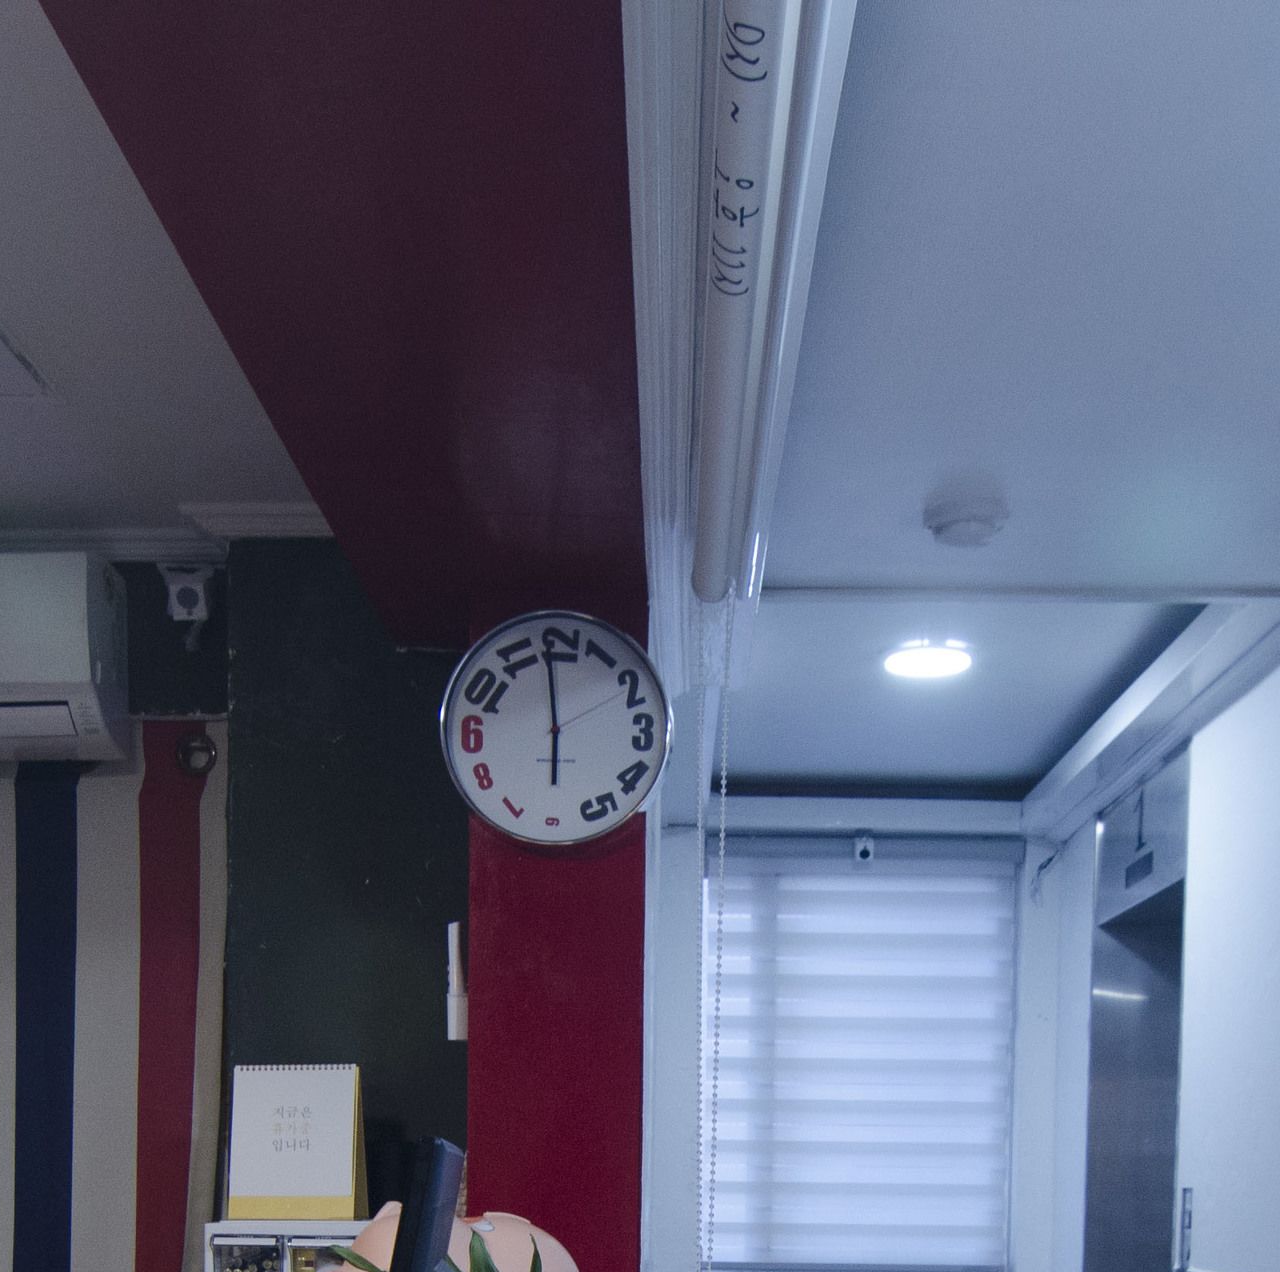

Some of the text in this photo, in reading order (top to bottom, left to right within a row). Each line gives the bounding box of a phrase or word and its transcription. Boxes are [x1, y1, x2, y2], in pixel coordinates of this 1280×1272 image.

[617, 668, 647, 710] 2
[632, 713, 654, 752] 3
[473, 762, 494, 791] 8
[616, 760, 650, 796] 4
[272, 1138, 311, 1152] 입니다
